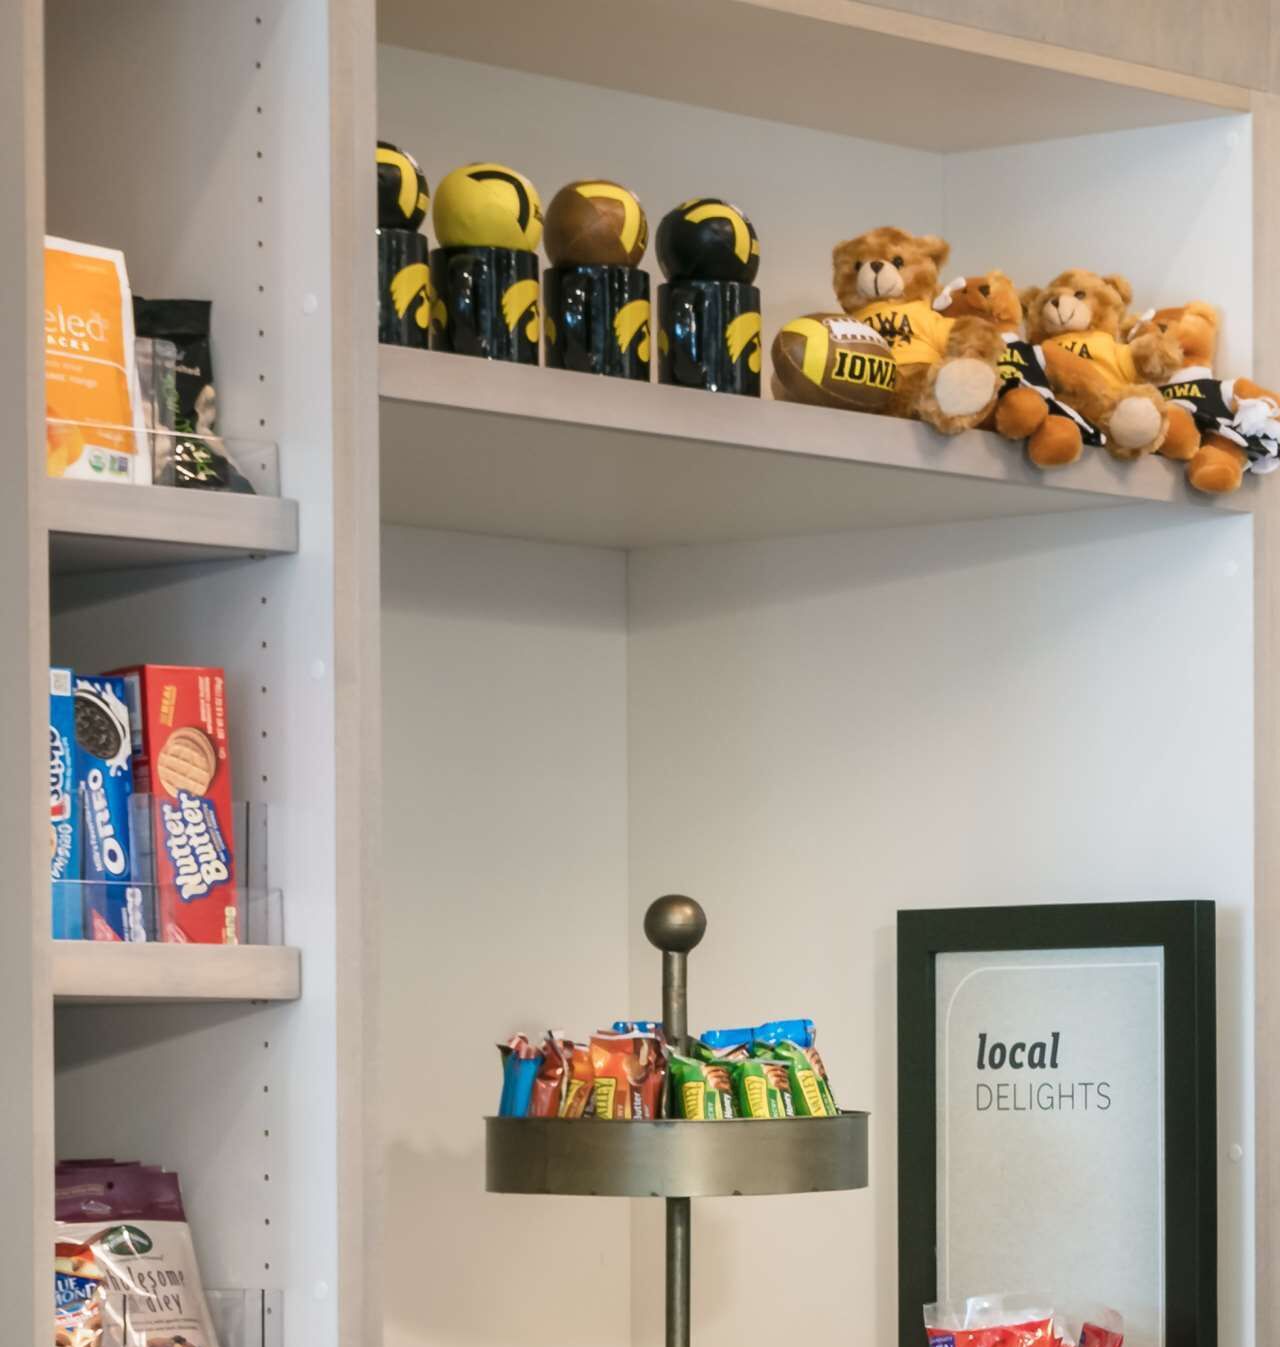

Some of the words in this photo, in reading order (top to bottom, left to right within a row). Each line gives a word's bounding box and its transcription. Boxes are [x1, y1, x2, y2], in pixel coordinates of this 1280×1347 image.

[87, 768, 126, 875] OREO
[162, 803, 209, 900] Nutter
[178, 791, 229, 885] Butter
[976, 1032, 1060, 1070] local
[976, 1082, 1112, 1110] DELIGHTS
